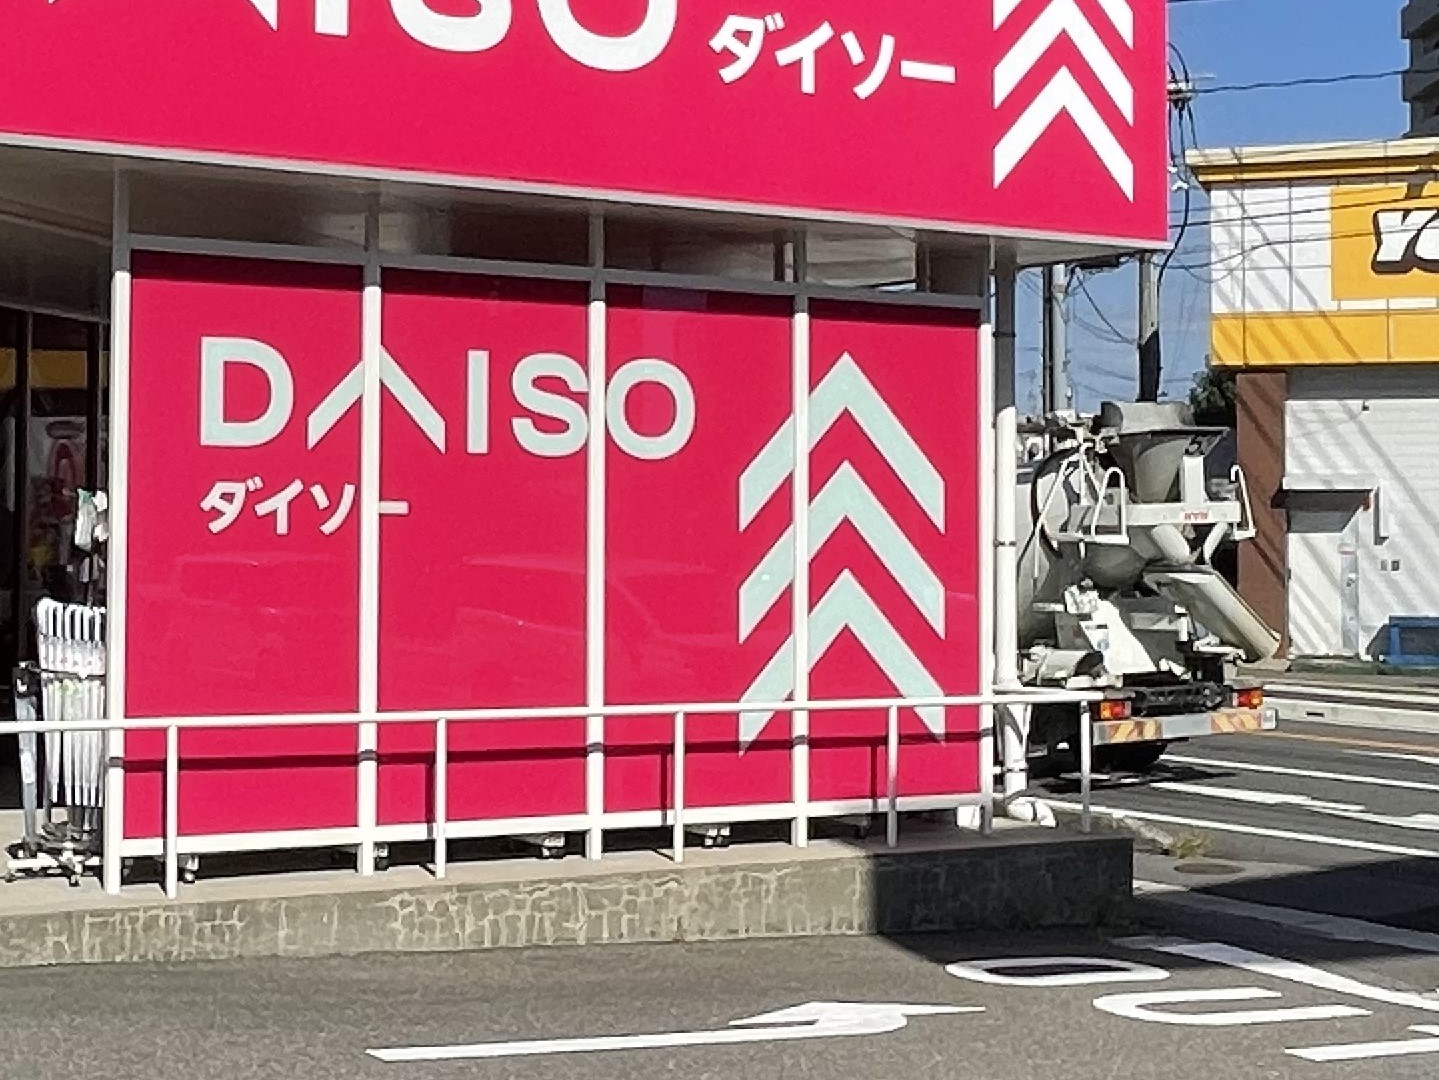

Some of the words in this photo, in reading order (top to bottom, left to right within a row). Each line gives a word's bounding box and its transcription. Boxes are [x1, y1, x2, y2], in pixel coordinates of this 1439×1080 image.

[707, 12, 956, 100] ダイソー
[200, 336, 696, 460] DAISO
[200, 476, 410, 536] ダイソー
